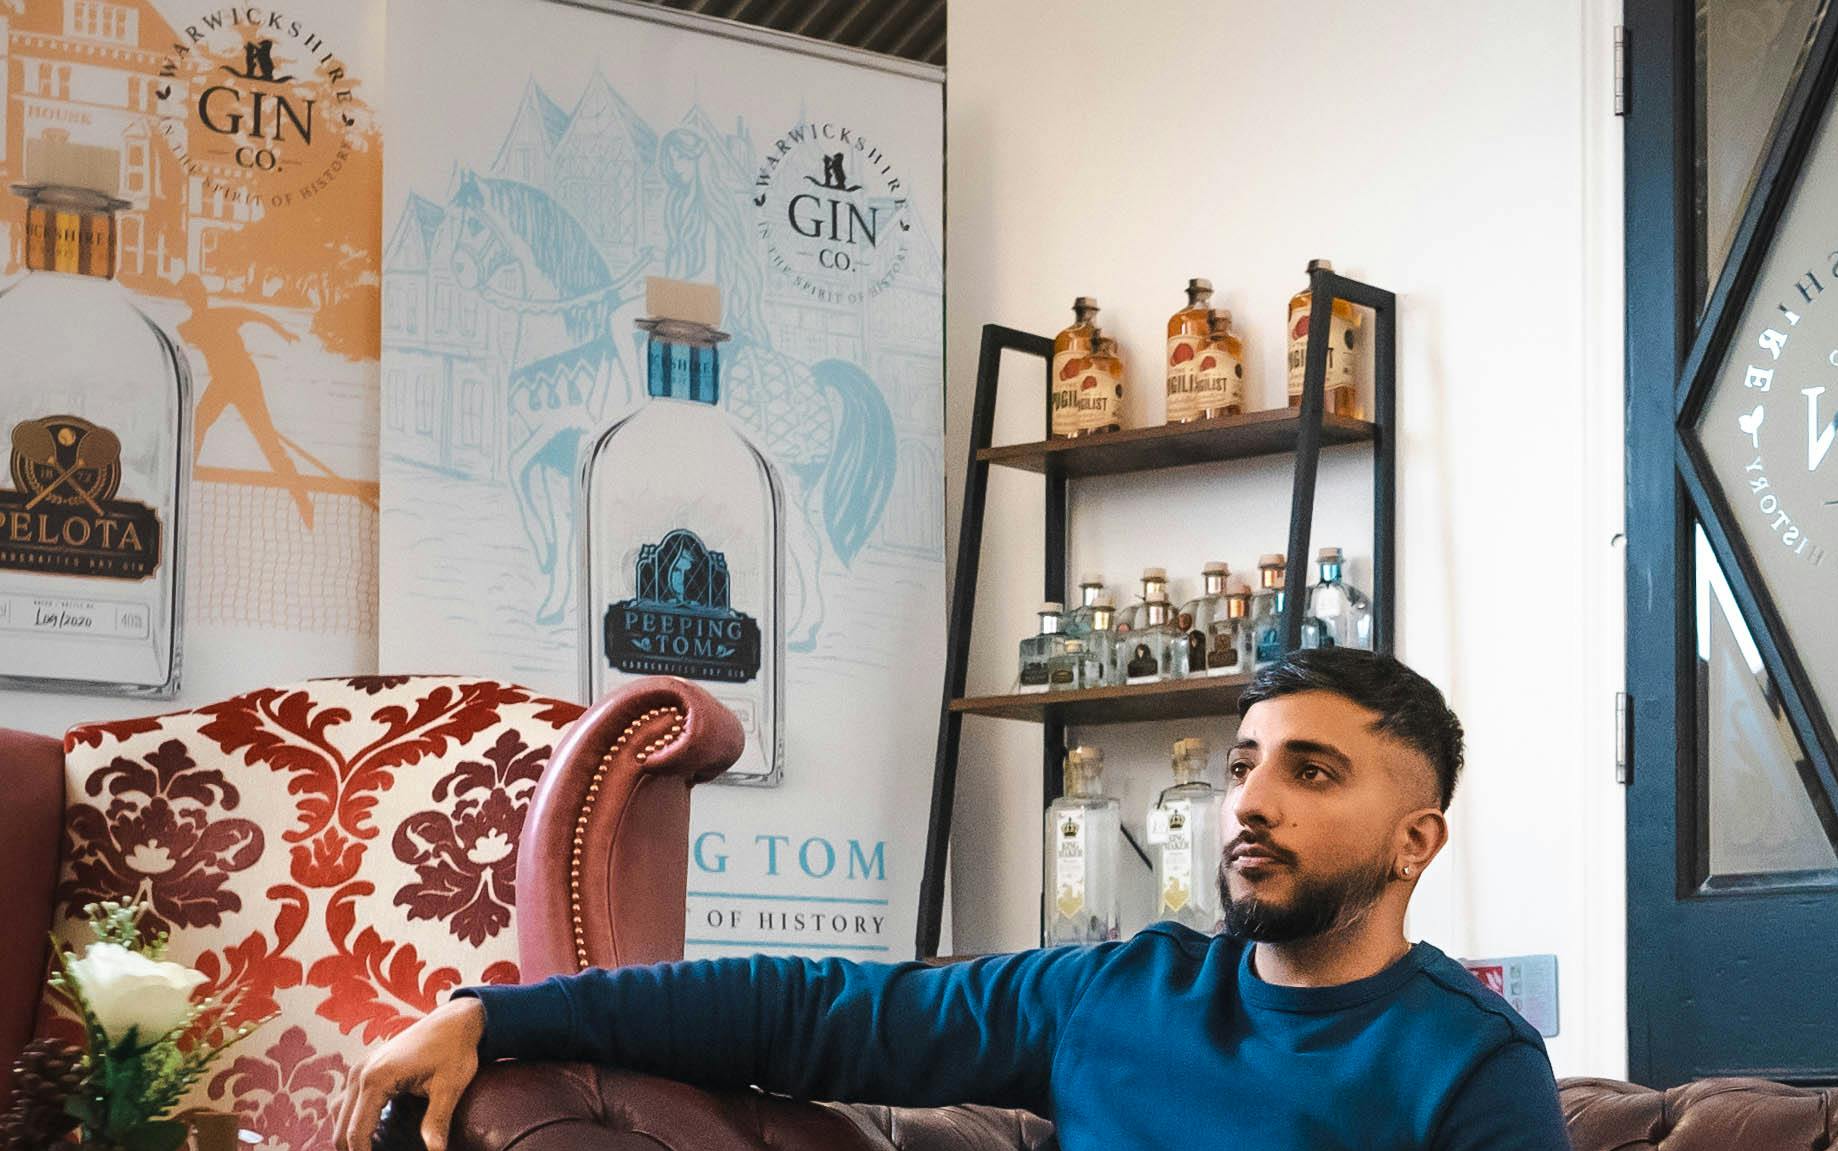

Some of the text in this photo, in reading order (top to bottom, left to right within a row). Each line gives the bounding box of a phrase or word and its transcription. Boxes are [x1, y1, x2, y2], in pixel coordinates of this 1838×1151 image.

[160, 8, 352, 103] WARWICKSHIRE
[199, 86, 316, 146] GIN
[235, 147, 283, 172] CO.
[756, 124, 907, 210] WARWICKSHIRE
[788, 194, 879, 248] GIN
[819, 249, 856, 272] CO.
[624, 611, 742, 640] PEEPING
[656, 634, 713, 657] TOM
[755, 835, 887, 880] TOM
[707, 910, 741, 928] OF
[759, 912, 885, 934] HISTORY
